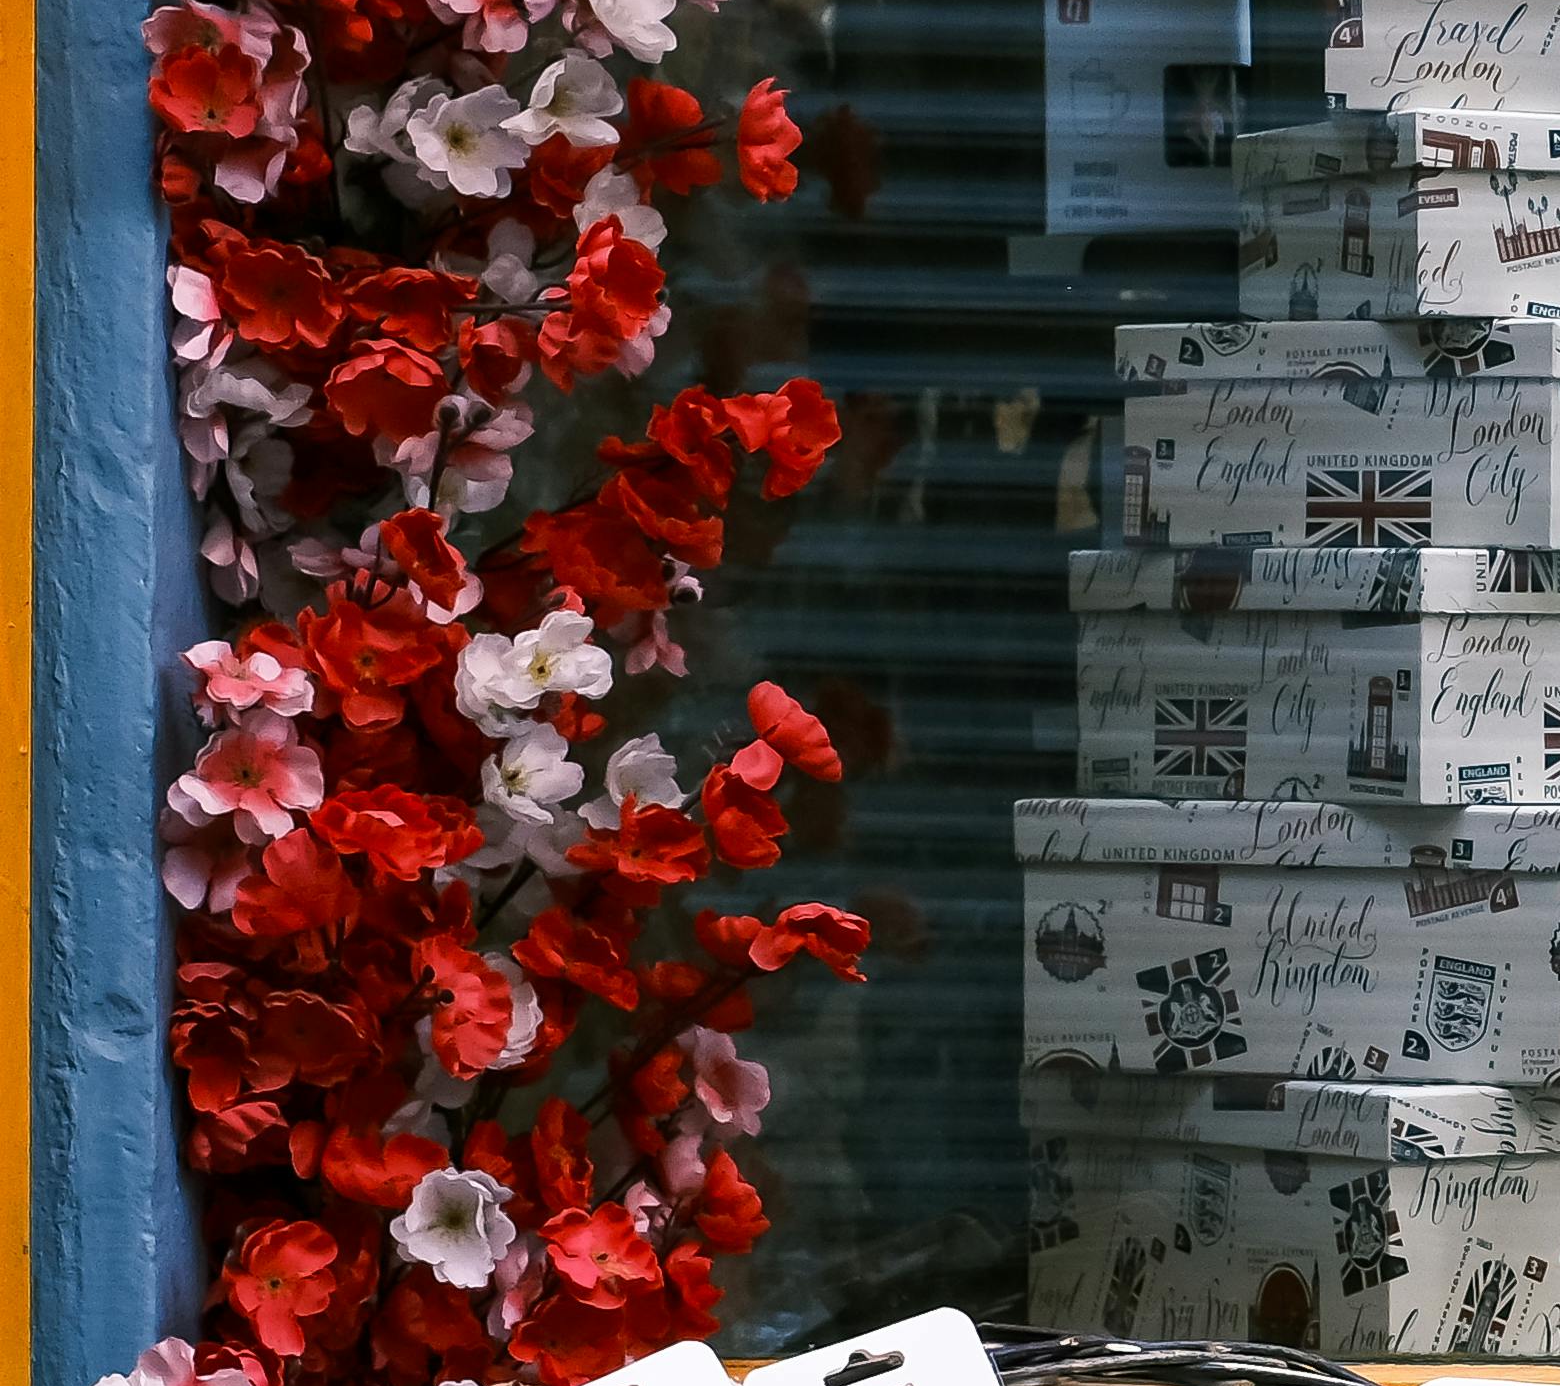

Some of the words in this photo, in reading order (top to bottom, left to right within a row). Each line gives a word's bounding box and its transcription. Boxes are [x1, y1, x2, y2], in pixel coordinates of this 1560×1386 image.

[1371, 31, 1520, 93] London
[1438, 392, 1553, 463] London
[1307, 454, 1359, 467] UNITED
[1365, 453, 1433, 467] KINGDOM
[1465, 444, 1538, 525] City
[1476, 553, 1487, 592] UNIT
[1427, 615, 1542, 666] London
[1462, 765, 1508, 780] ENGLAND
[1102, 847, 1158, 861] UNITED
[1163, 848, 1236, 862] KINGDOM
[1439, 959, 1495, 978] ENGLAND
[1409, 1161, 1538, 1232] Kingdom
